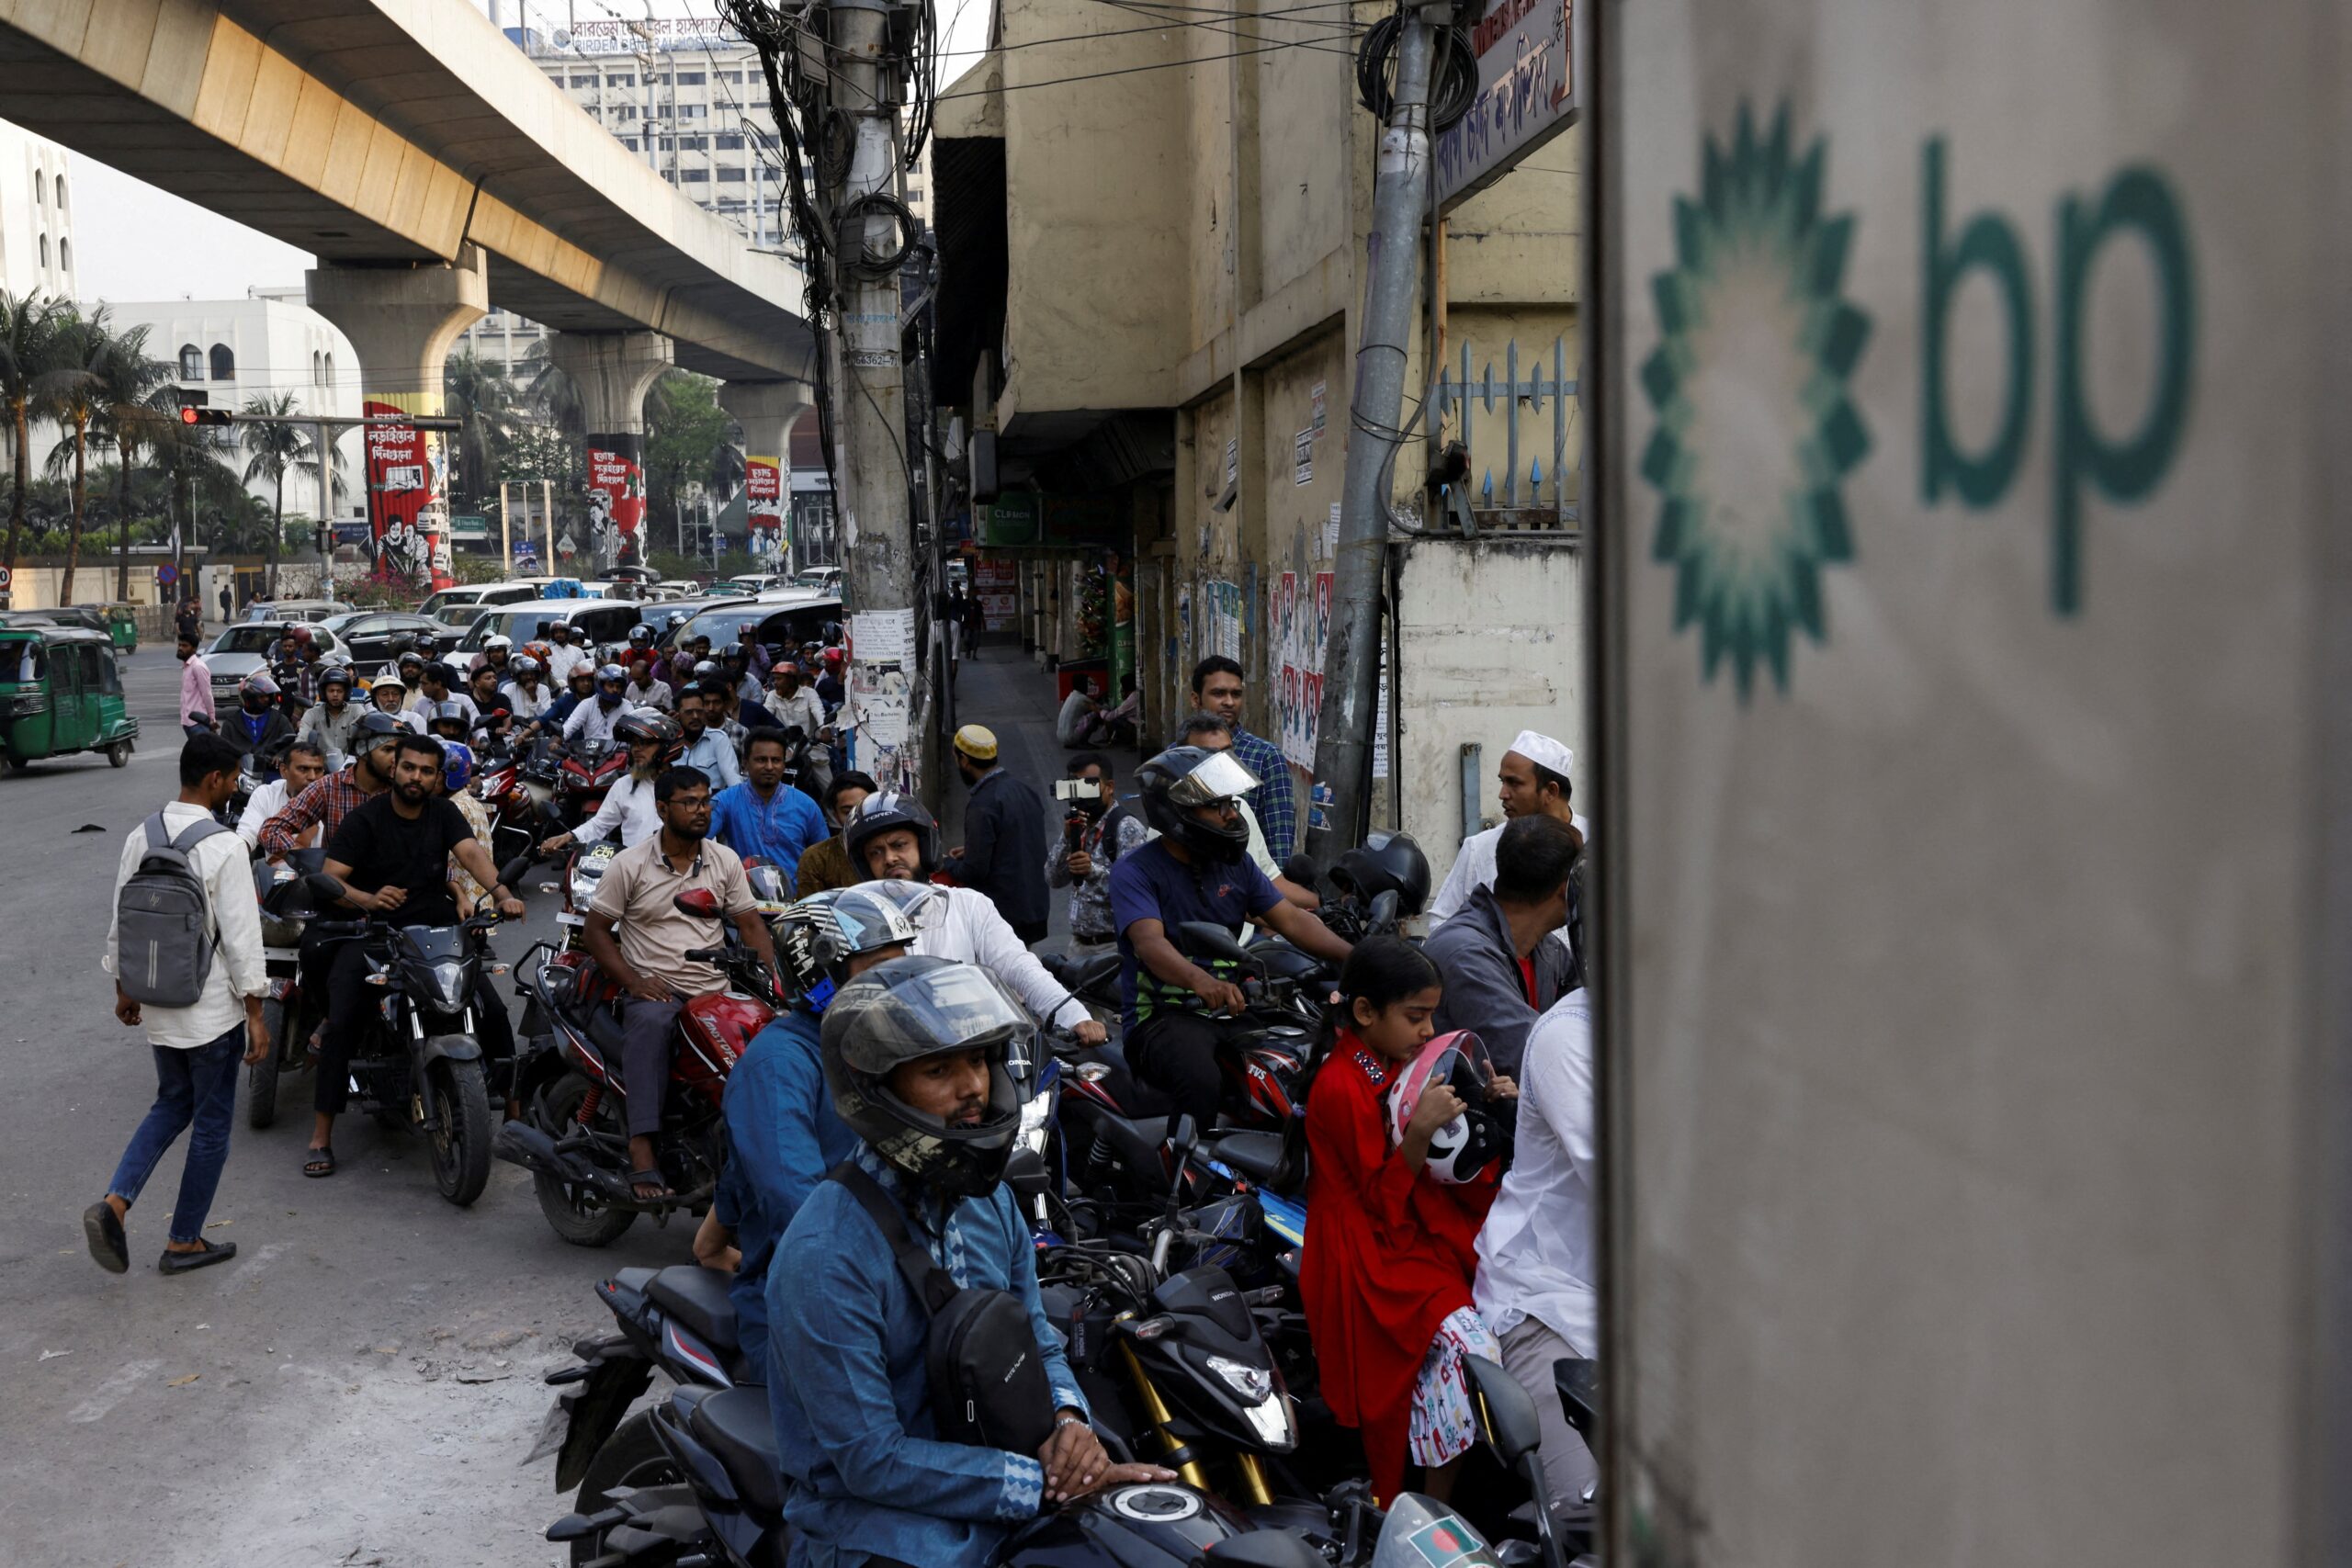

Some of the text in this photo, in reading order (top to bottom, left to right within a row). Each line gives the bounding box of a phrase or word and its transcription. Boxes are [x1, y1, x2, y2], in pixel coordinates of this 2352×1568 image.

[574, 39, 618, 52] BIRDEM
[1919, 133, 2196, 618] bp
[1249, 1064, 1267, 1080] TVS
[1212, 1291, 1235, 1302] HONDA
